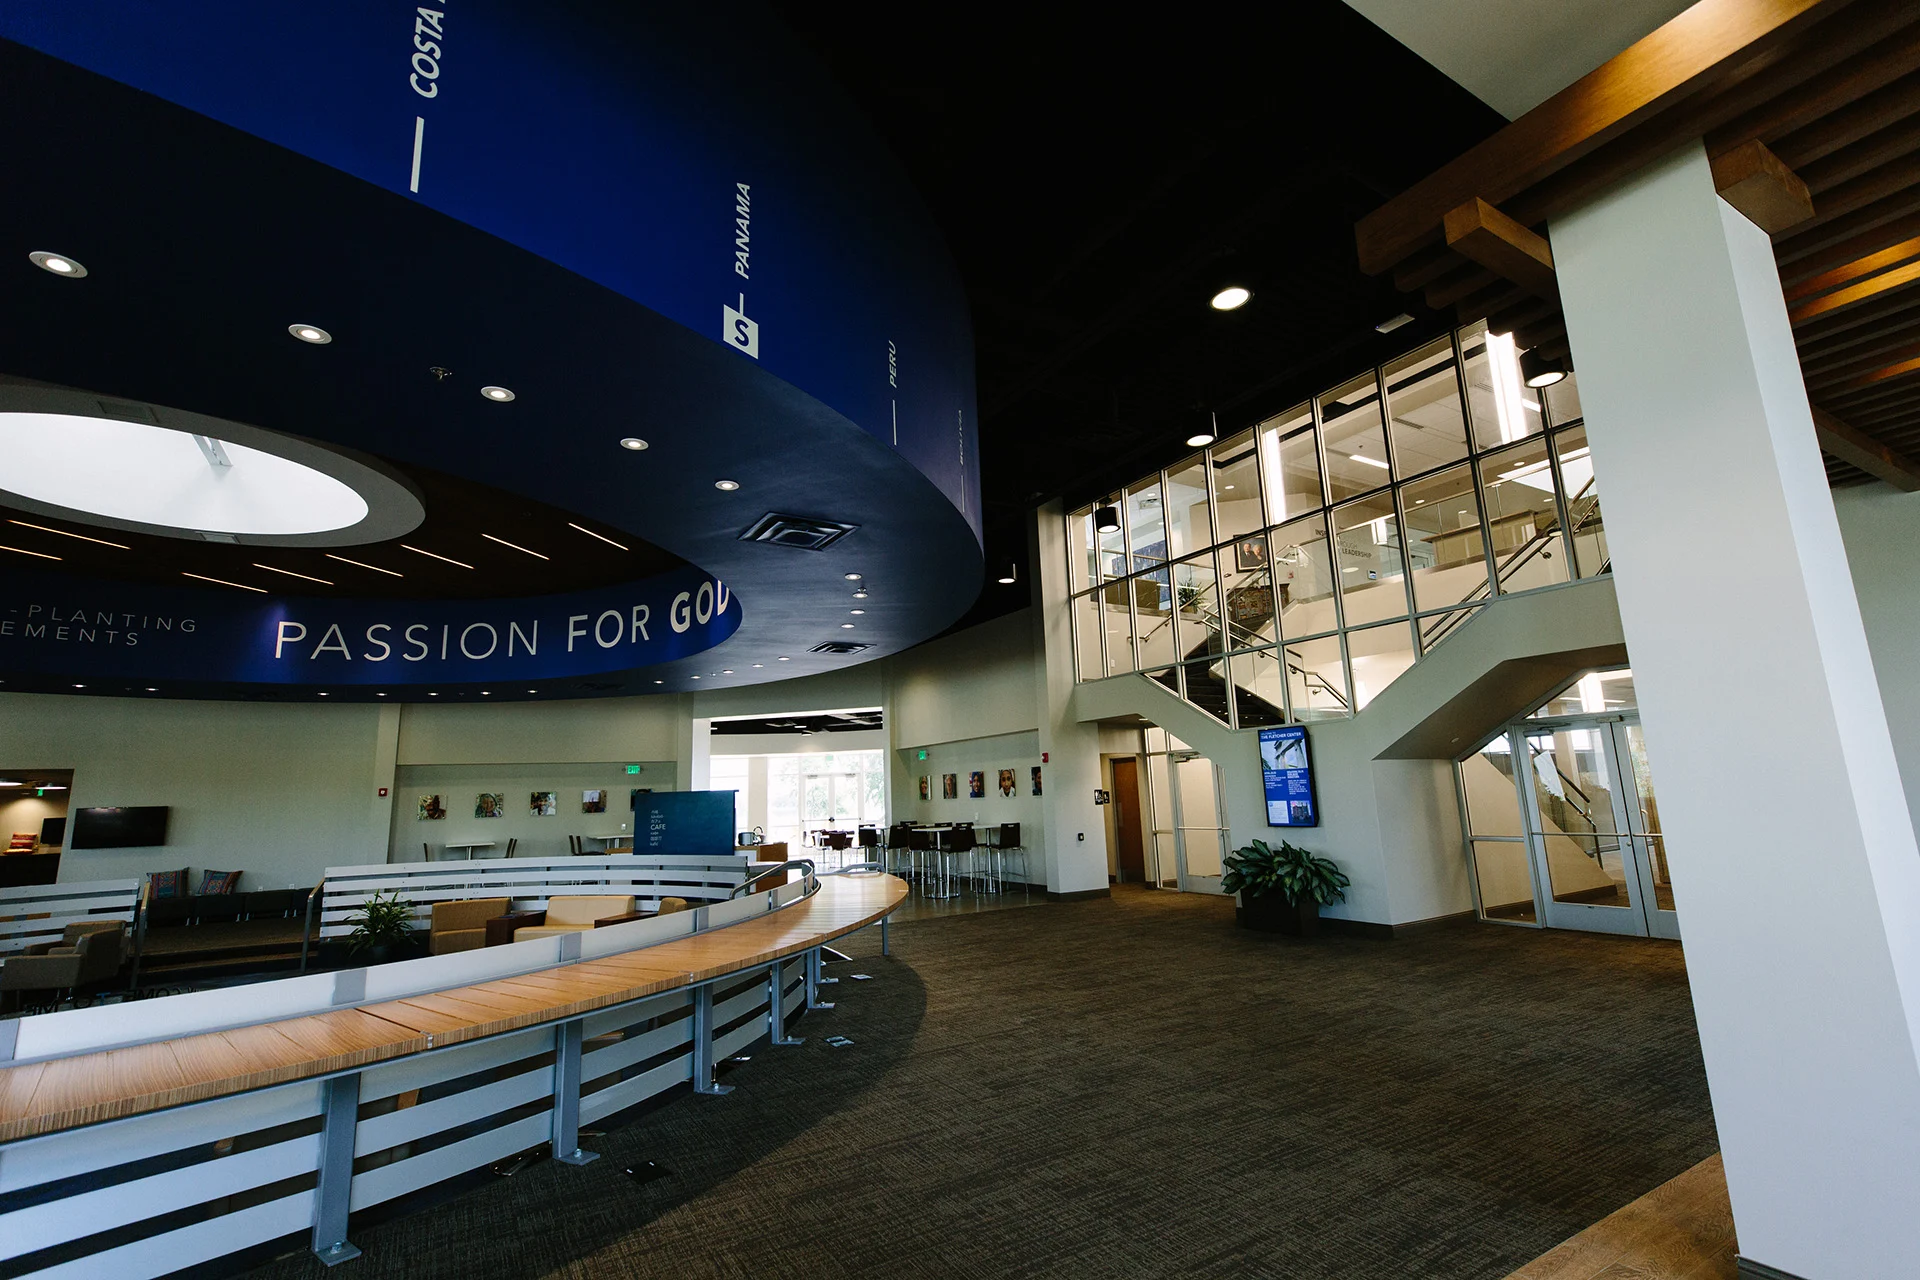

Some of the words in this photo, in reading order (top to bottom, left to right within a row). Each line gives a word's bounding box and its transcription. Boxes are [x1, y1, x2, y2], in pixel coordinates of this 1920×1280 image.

[409, 6, 444, 98] COSTA
[735, 182, 750, 280] PANAMA
[734, 318, 750, 347] S
[888, 340, 897, 389] PERU
[1342, 548, 1372, 558] LEADERSHIP
[0, 621, 139, 646] EMENTS
[275, 620, 538, 662] PASSION
[567, 604, 650, 652] FOR
[670, 579, 730, 634] GOD
